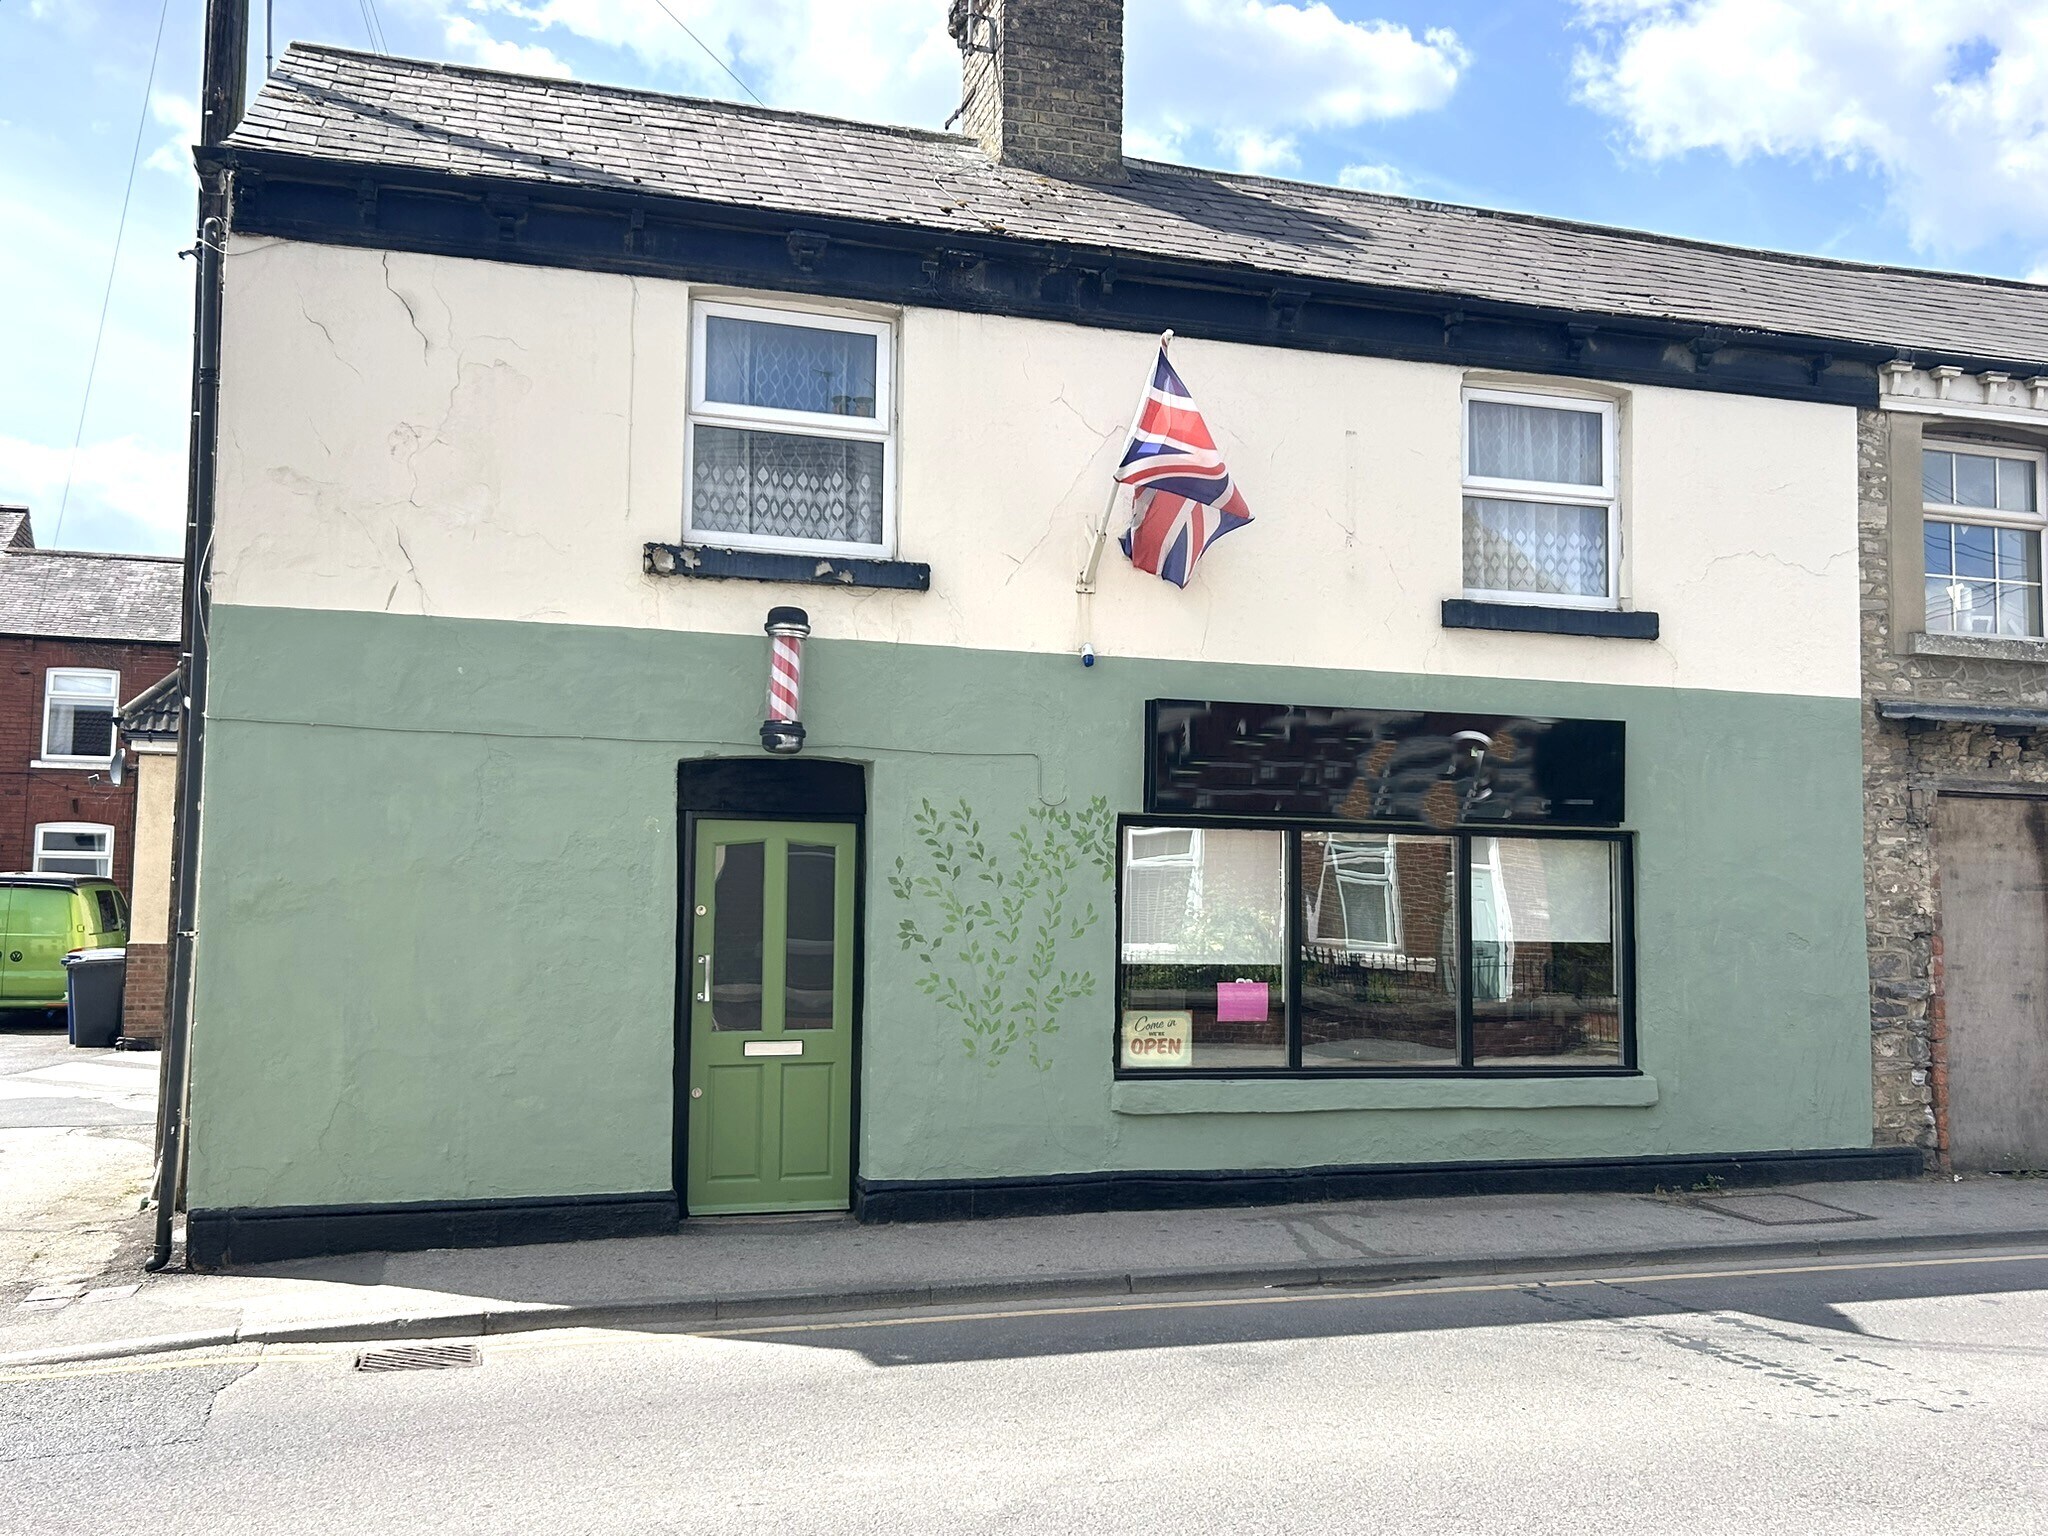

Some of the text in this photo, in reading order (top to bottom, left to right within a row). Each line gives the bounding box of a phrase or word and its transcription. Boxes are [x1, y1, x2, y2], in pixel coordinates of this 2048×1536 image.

[1135, 1016, 1177, 1032] Come in
[1131, 1038, 1181, 1054] OPEN
